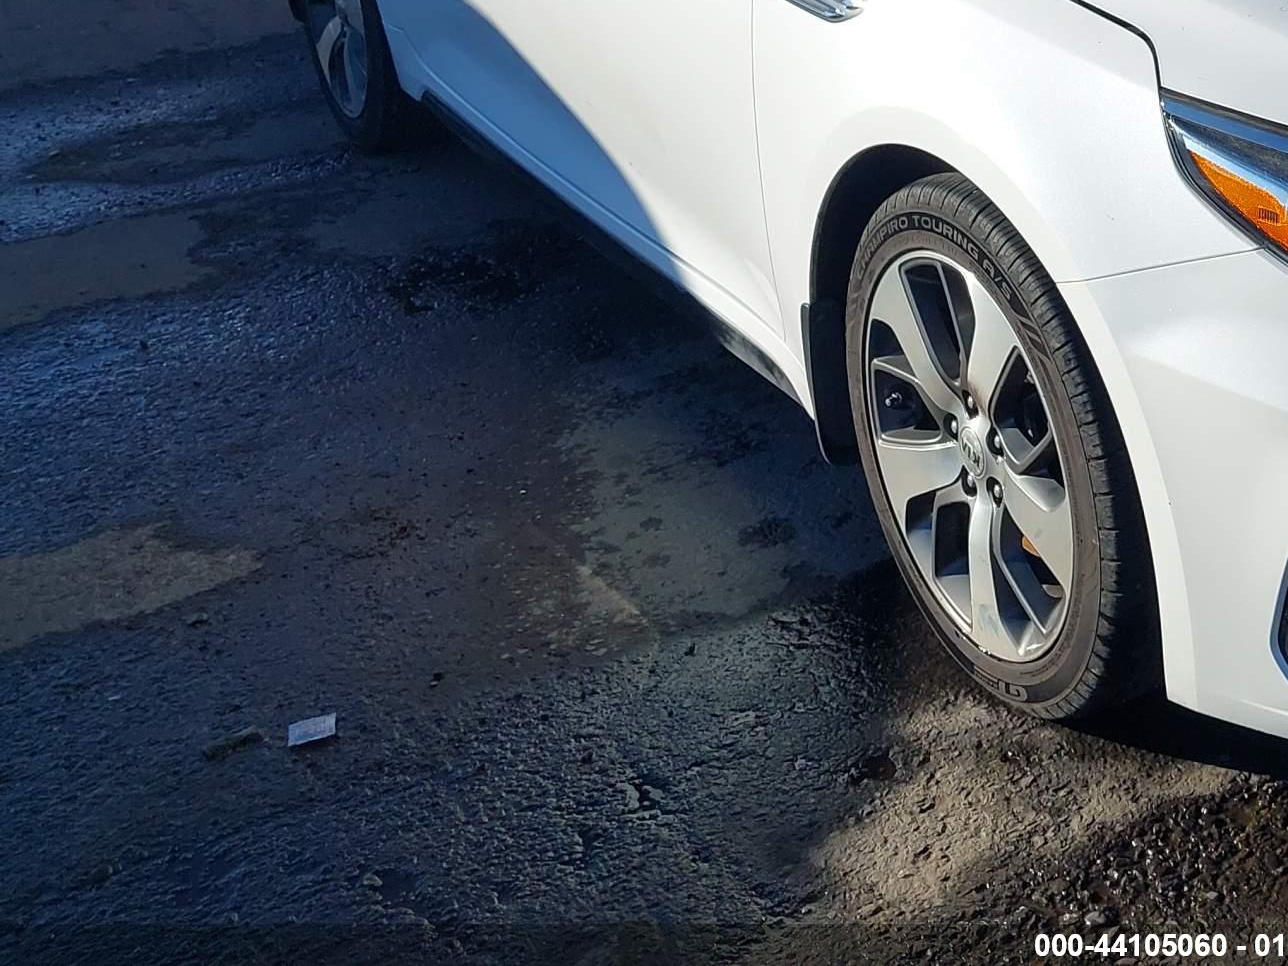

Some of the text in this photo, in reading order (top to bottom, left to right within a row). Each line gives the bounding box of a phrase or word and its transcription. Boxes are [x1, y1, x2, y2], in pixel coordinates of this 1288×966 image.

[855, 215, 1013, 301] CHAMPIRO TOURING A/S
